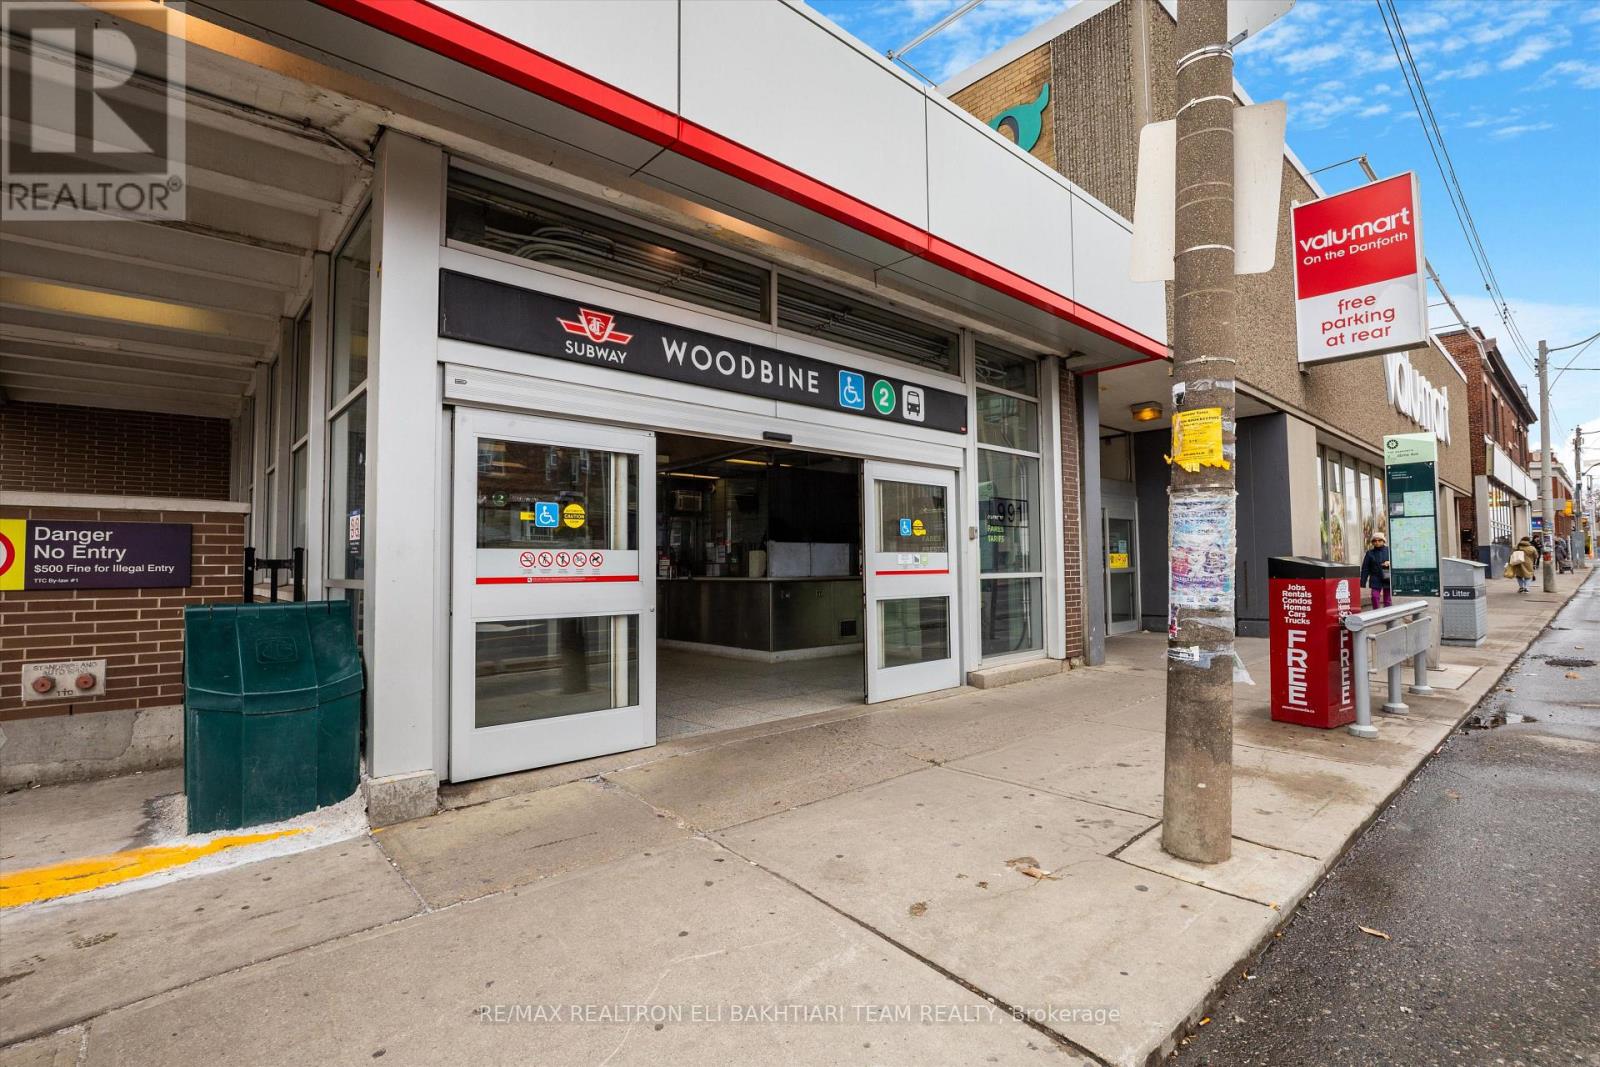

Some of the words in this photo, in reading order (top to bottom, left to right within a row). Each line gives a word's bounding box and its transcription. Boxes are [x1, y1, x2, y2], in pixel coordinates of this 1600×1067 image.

[1303, 255, 1321, 266] On
[1325, 249, 1345, 261] the
[1349, 232, 1408, 254] Danforth
[1338, 295, 1376, 314] free
[1321, 307, 1395, 334] parking
[1326, 333, 1345, 347] at
[1351, 325, 1391, 343] rear
[565, 340, 627, 364] SUBWAY
[661, 336, 819, 394] WOODBINE
[879, 387, 889, 407] 2
[997, 502, 1022, 523] 991
[34, 526, 113, 545] Danger
[34, 545, 65, 559] No
[72, 545, 127, 562] Entry
[34, 564, 64, 574] $500
[66, 565, 91, 573] Fine
[94, 564, 109, 573] for
[112, 564, 145, 574] Illegal
[147, 564, 175, 574] Entry
[1282, 590, 1313, 598] Rentals
[1287, 583, 1306, 591] Jobs
[1452, 589, 1470, 597] Litter
[1282, 597, 1313, 605] Condos
[1283, 603, 1311, 612] Homes
[1284, 616, 1311, 625] Trucks
[1288, 610, 1306, 618] Cars
[1287, 629, 1309, 706] FREE
[1340, 629, 1351, 705] FREE
